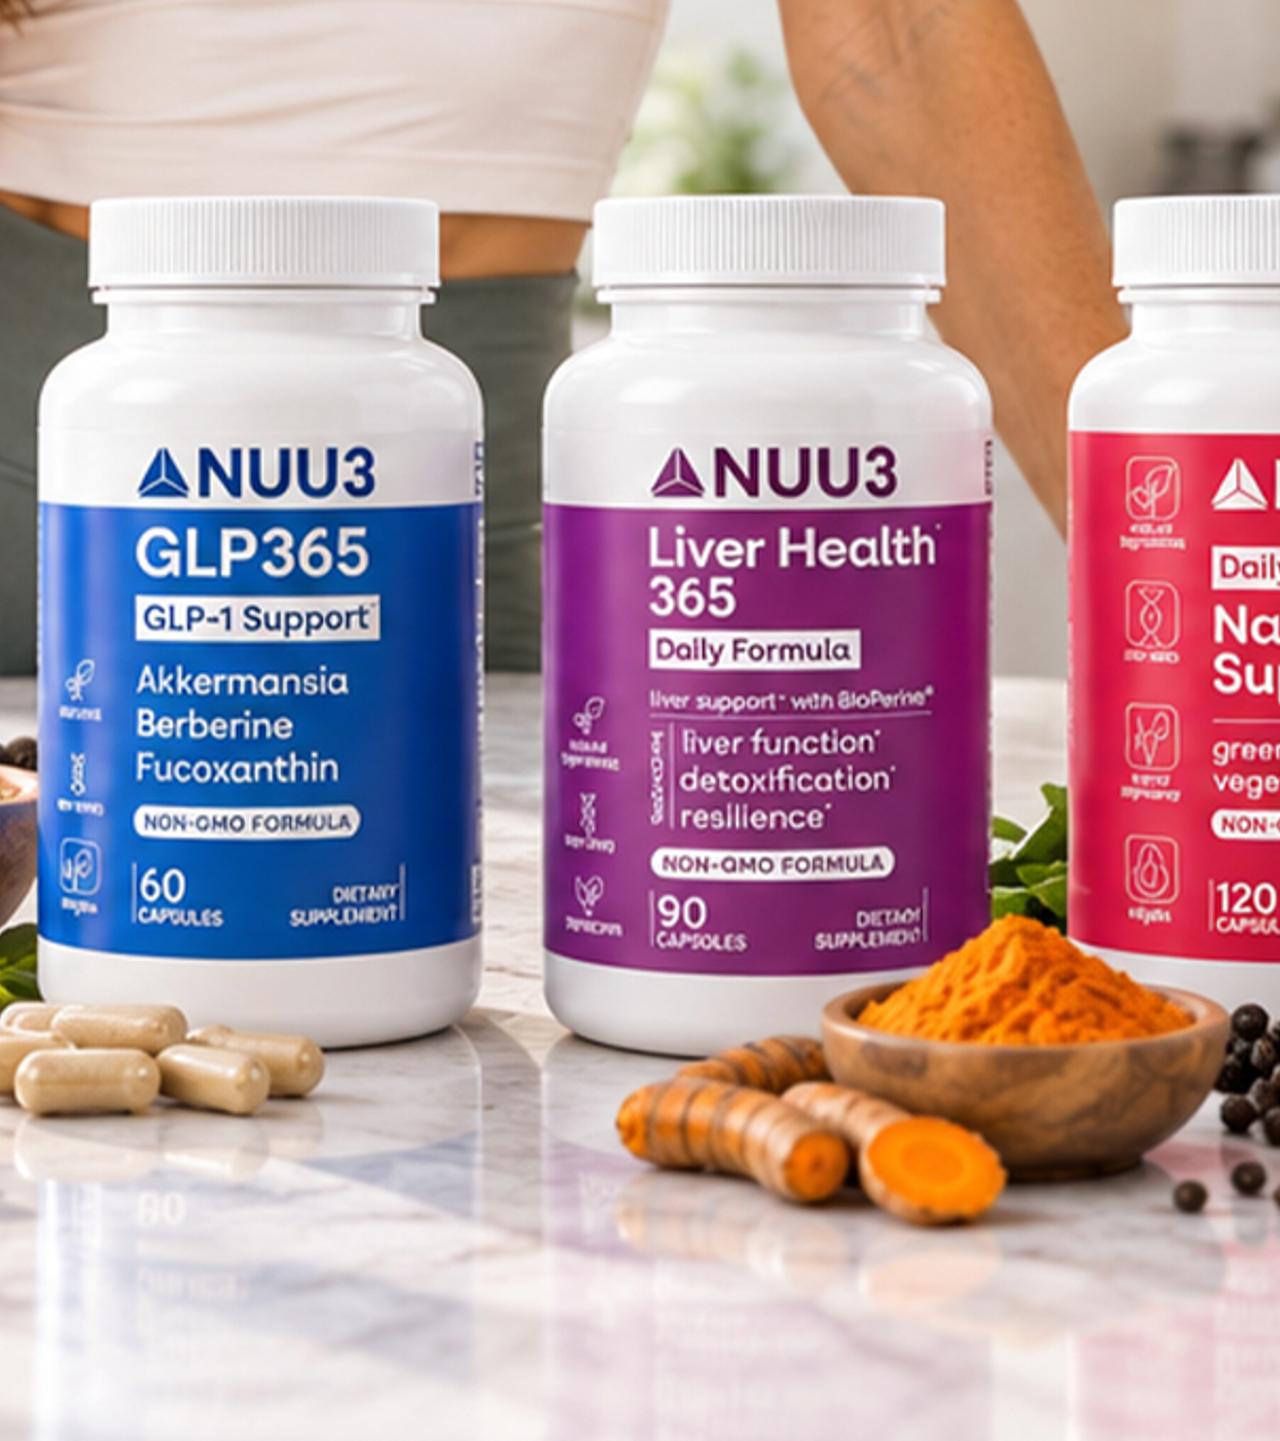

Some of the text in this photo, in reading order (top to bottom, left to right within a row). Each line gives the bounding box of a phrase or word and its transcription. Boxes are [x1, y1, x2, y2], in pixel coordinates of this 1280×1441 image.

[199, 447, 375, 498] NUU3
[715, 446, 897, 498] NUU3
[136, 526, 369, 578] GLP365
[649, 525, 937, 569] Liver Health
[649, 575, 736, 618] 365
[143, 603, 371, 637] GLP-1 Support
[657, 637, 852, 667] Daily Formula
[136, 664, 349, 696] Akkermansia
[649, 689, 690, 709] liver
[791, 688, 834, 710] with
[136, 708, 293, 740] Berberine
[682, 728, 744, 756] liver
[136, 751, 339, 784] Fucoxanthin
[252, 813, 352, 834] FORMULA
[780, 855, 885, 877] FORMULA
[140, 867, 186, 904] 60
[1216, 883, 1277, 915] 120
[657, 895, 707, 928] 90
